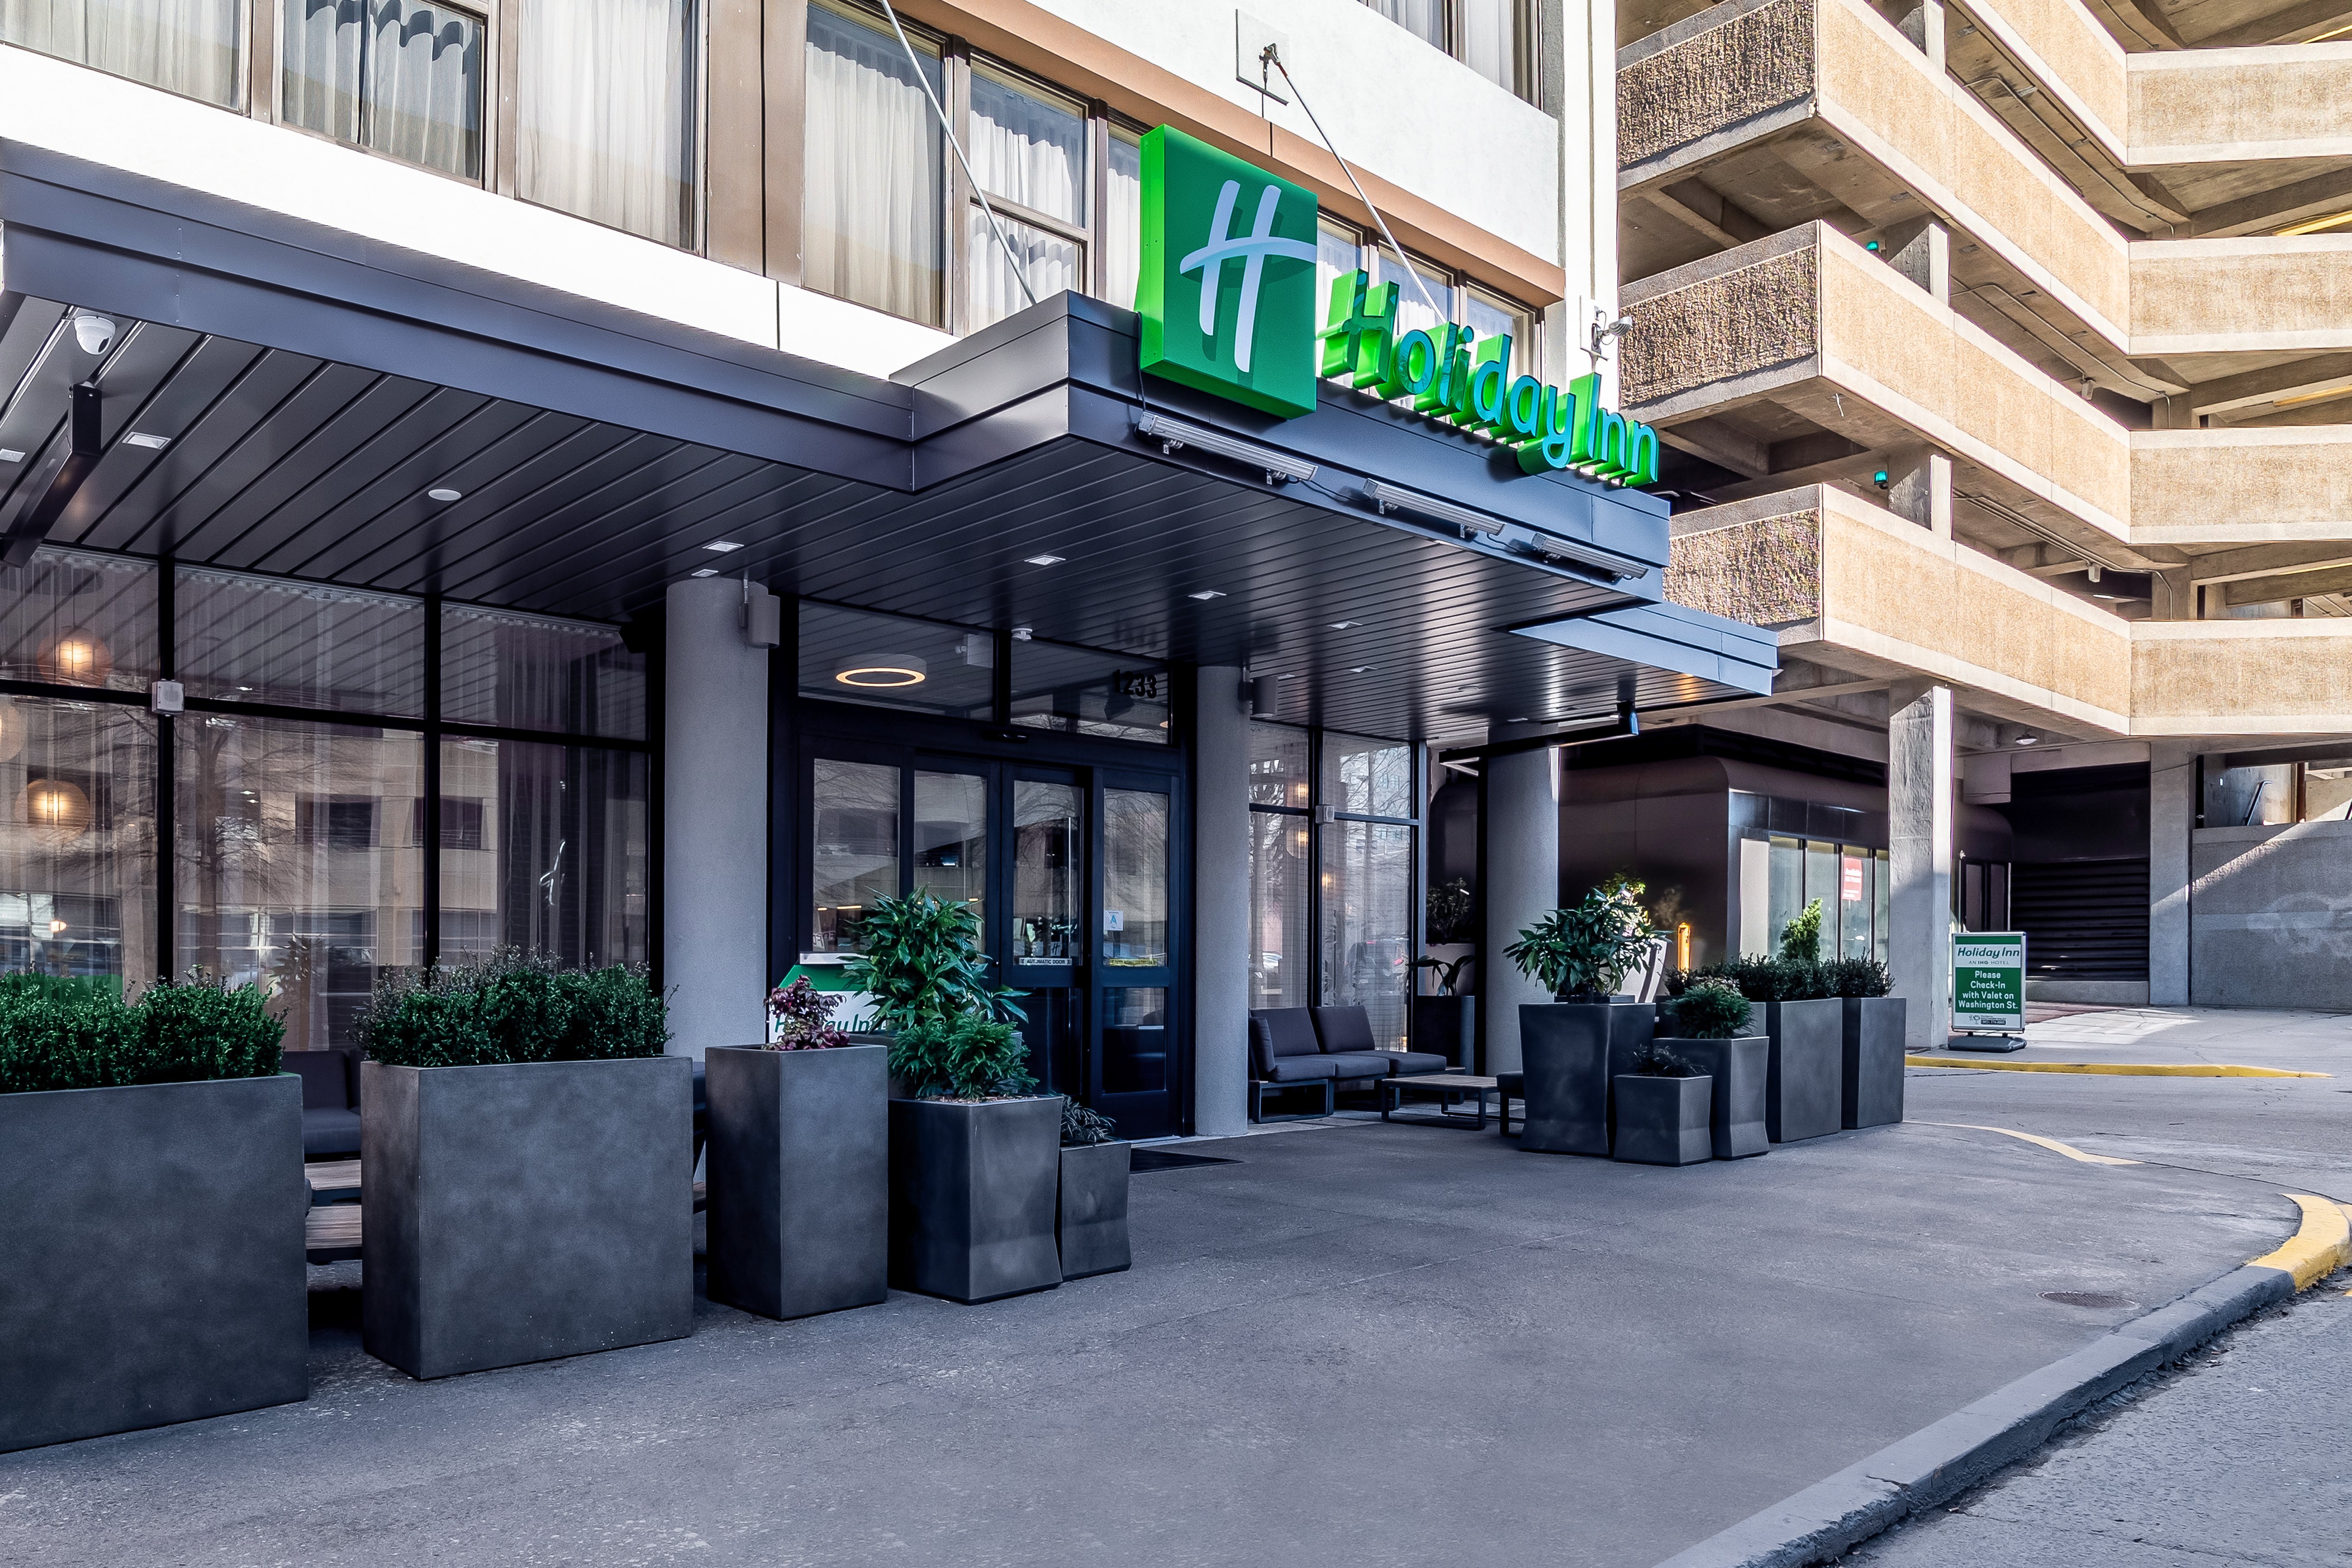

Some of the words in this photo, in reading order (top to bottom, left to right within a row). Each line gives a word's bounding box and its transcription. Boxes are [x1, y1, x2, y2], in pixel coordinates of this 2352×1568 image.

[1318, 268, 1576, 475] Holiday
[1576, 373, 1659, 486] Inn
[1113, 669, 1157, 699] 1233
[1958, 947, 2000, 959] Holiday
[2002, 947, 2020, 956] Inn
[1959, 1000, 2005, 1010] Washington
[2006, 1001, 2019, 1009] St.
[852, 1014, 883, 1032] In
